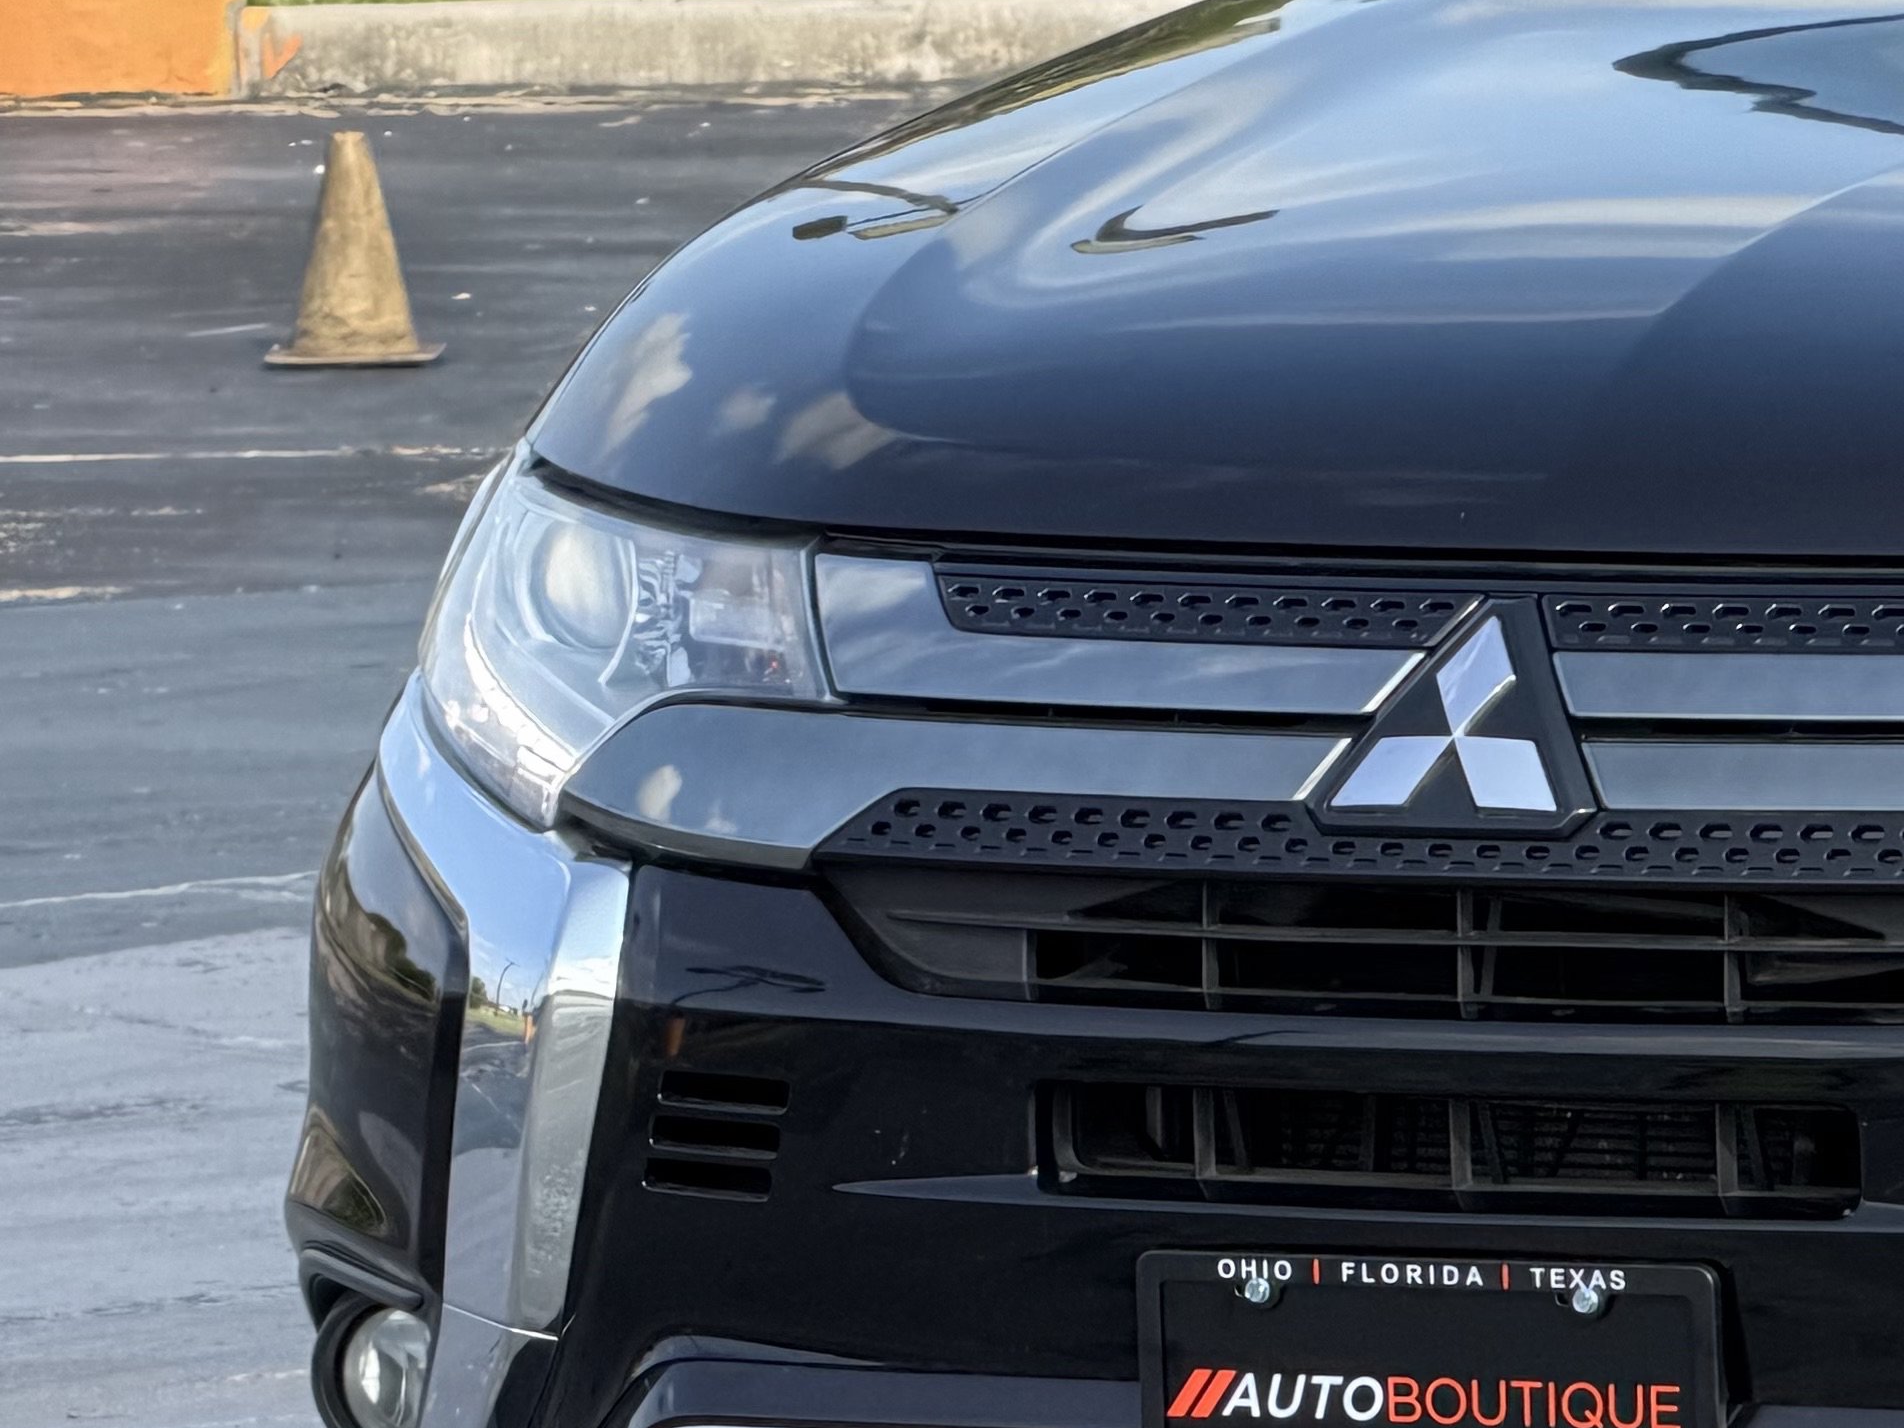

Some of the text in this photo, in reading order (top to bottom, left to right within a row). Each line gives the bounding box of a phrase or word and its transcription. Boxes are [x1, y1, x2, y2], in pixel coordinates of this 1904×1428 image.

[1217, 1258, 1627, 1291] OHIO FLORIDA TEXAS
